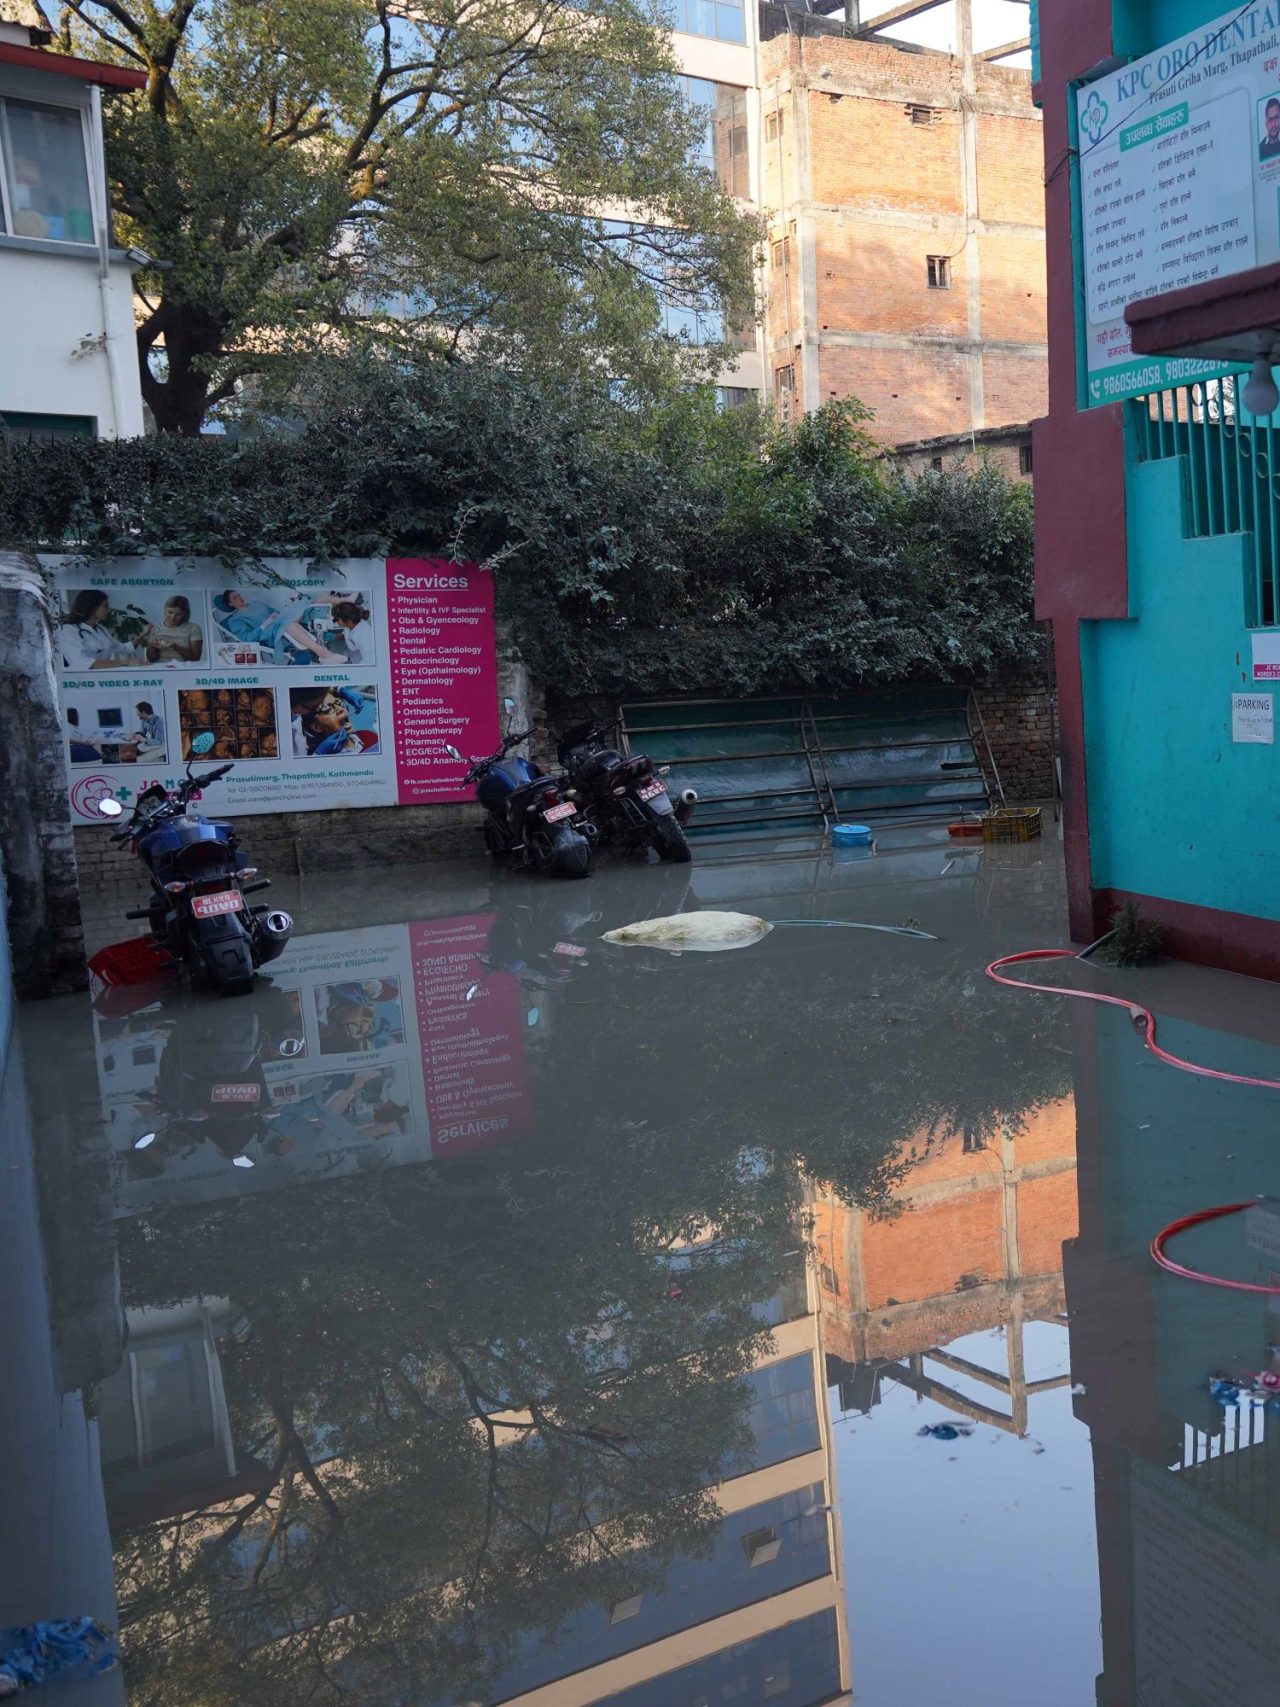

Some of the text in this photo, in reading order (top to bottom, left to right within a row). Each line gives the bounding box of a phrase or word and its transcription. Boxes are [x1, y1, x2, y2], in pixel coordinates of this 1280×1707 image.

[1117, 64, 1152, 102] KPC
[1158, 41, 1198, 82] ORO
[1150, 86, 1176, 105] Prasuti
[1178, 73, 1201, 90] Griha
[1202, 63, 1228, 80] Marg,
[1231, 35, 1279, 67] Thapathali,
[1104, 365, 1163, 395] 9860566058,
[90, 578, 174, 586] SAFE ABORTION
[393, 573, 468, 588] Services
[397, 596, 437, 605] Physician
[398, 607, 429, 615] Infertility
[399, 627, 440, 635] Radiology
[400, 647, 436, 655] Pediatric
[401, 668, 417, 676] Eye
[314, 674, 350, 682] DENTAL
[98, 679, 129, 687] VIDEO
[403, 697, 443, 705] Pediatrics
[1238, 699, 1269, 710] PARKING
[403, 707, 454, 716] Orthopedics
[404, 717, 470, 726] General Surgery
[404, 727, 463, 736] Physiotherapy
[405, 738, 446, 746] Pharmacy
[406, 758, 431, 766] 3D/4D
[328, 769, 374, 778] Kathmandu
